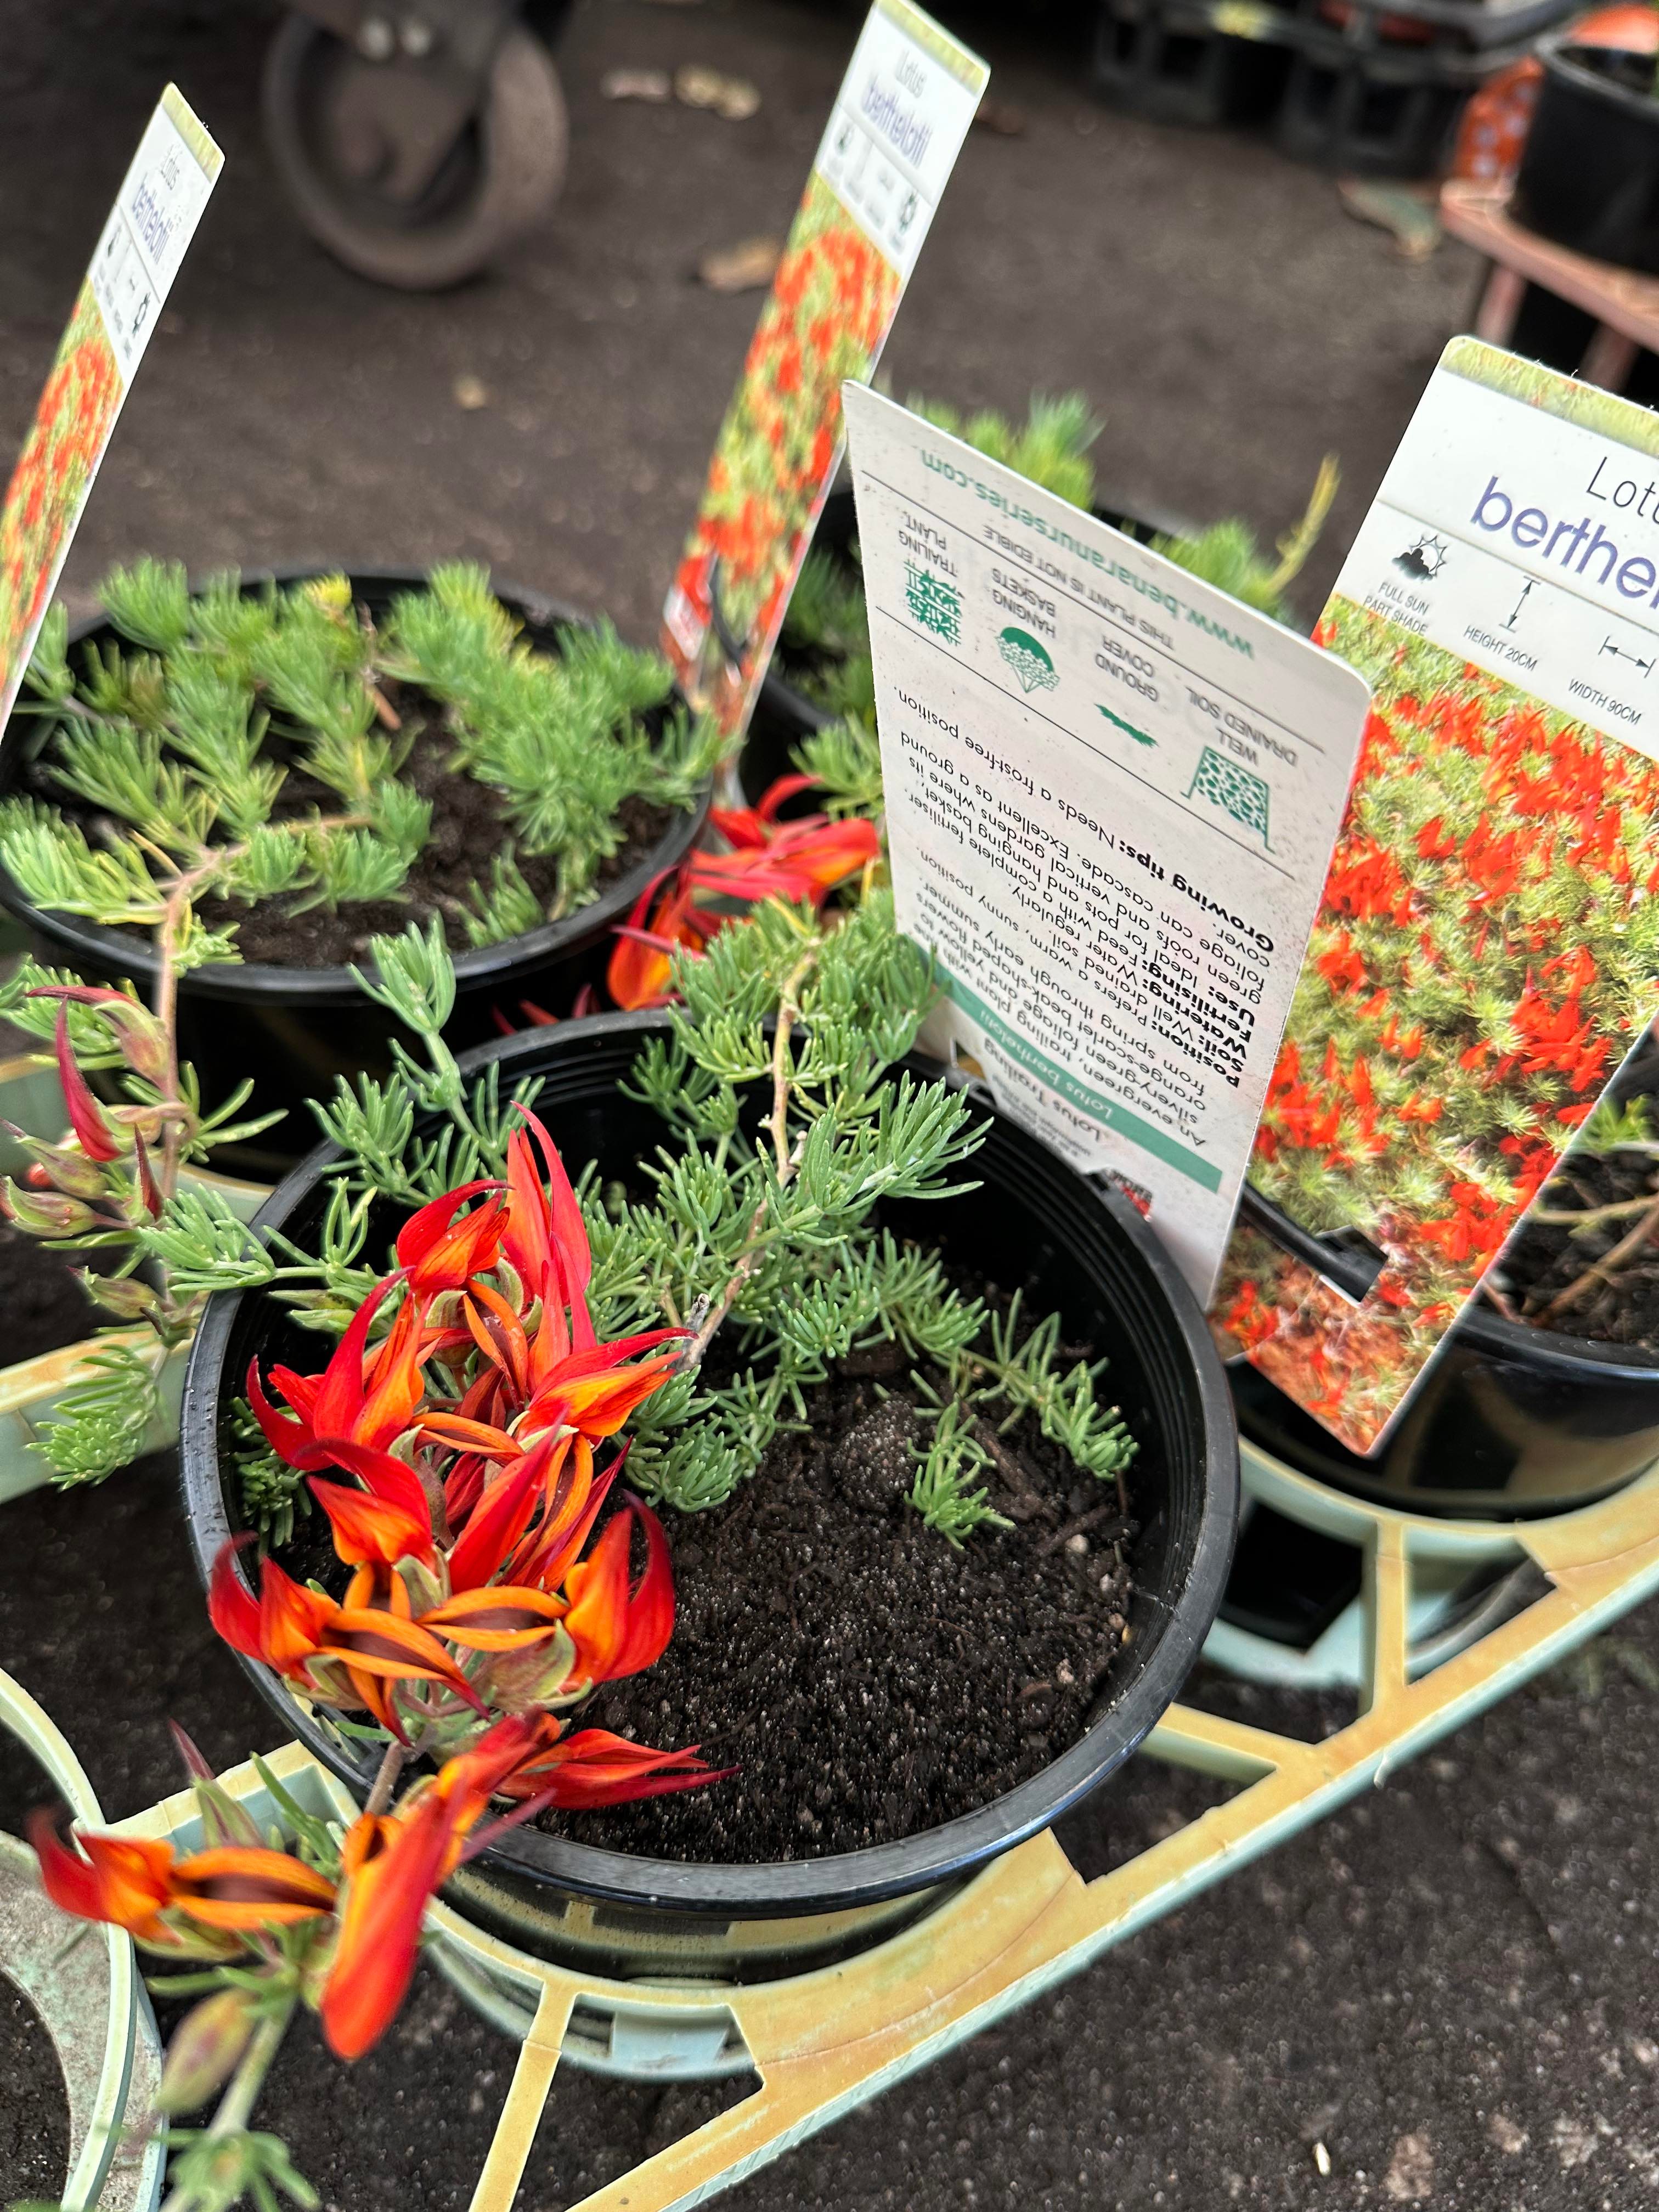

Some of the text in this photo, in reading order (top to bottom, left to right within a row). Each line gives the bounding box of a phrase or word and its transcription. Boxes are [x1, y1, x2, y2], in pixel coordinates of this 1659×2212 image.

[898, 529, 957, 578] TRAILING
[904, 510, 946, 550] PLANT
[921, 449, 1254, 660] www.benaranurseries.com
[983, 524, 1174, 650] THIS PLANT IS NOT EDIBLE
[992, 567, 1056, 617] BASKETS
[1378, 582, 1430, 616] FULL SUN
[992, 588, 1055, 639] HANGING
[1362, 595, 1429, 636] PART SHADE
[1102, 635, 1154, 678] COVER
[1463, 625, 1538, 673] HEIGHT 20CM
[1094, 653, 1159, 702] GROUND
[1568, 678, 1643, 726] WIDTH 90CM
[1185, 686, 1297, 766] DRAINED SOIL
[1215, 727, 1257, 765] WELL
[893, 686, 1274, 952] Growing tips: Needs a frost-free position.
[900, 731, 1265, 992] foliage can cascade. Excellent as a ground
[909, 757, 1261, 1005] green roofs and vertical gardens where its
[904, 789, 1252, 1043] Fertilising: Feed with a complete fertiliser.
[919, 912, 934, 931] to
[921, 782, 1255, 1027] Use: Ideal for pots and hanging basket,
[916, 847, 1240, 1088] Position: Prefers a warm, sunny position.
[938, 928, 984, 972] yellow
[943, 948, 971, 978] with
[984, 930, 1024, 966] early
[1212, 923, 1270, 967] cover.
[989, 970, 1018, 999] and
[1008, 883, 1247, 1059] Watering: Water regularly.
[1030, 965, 1093, 1020] through
[916, 892, 1206, 1110] orange-scarlet beak-shaped flowers
[975, 978, 1011, 1014] plant
[1048, 929, 1244, 1073] Soil: Well drained soil.
[1016, 1009, 1071, 1062] trailing
[1022, 999, 1079, 1051] foliage
[1100, 1013, 1156, 1059] spring
[984, 1037, 1046, 1107] Trailing
[1078, 1057, 1173, 1125] evergreen,
[1085, 1045, 1198, 1124] silvery-green
[1163, 1059, 1204, 1096] from
[1052, 1100, 1101, 1142] Lotus
[1066, 1082, 1113, 1119] Lotus
[1179, 1125, 1206, 1146] An
